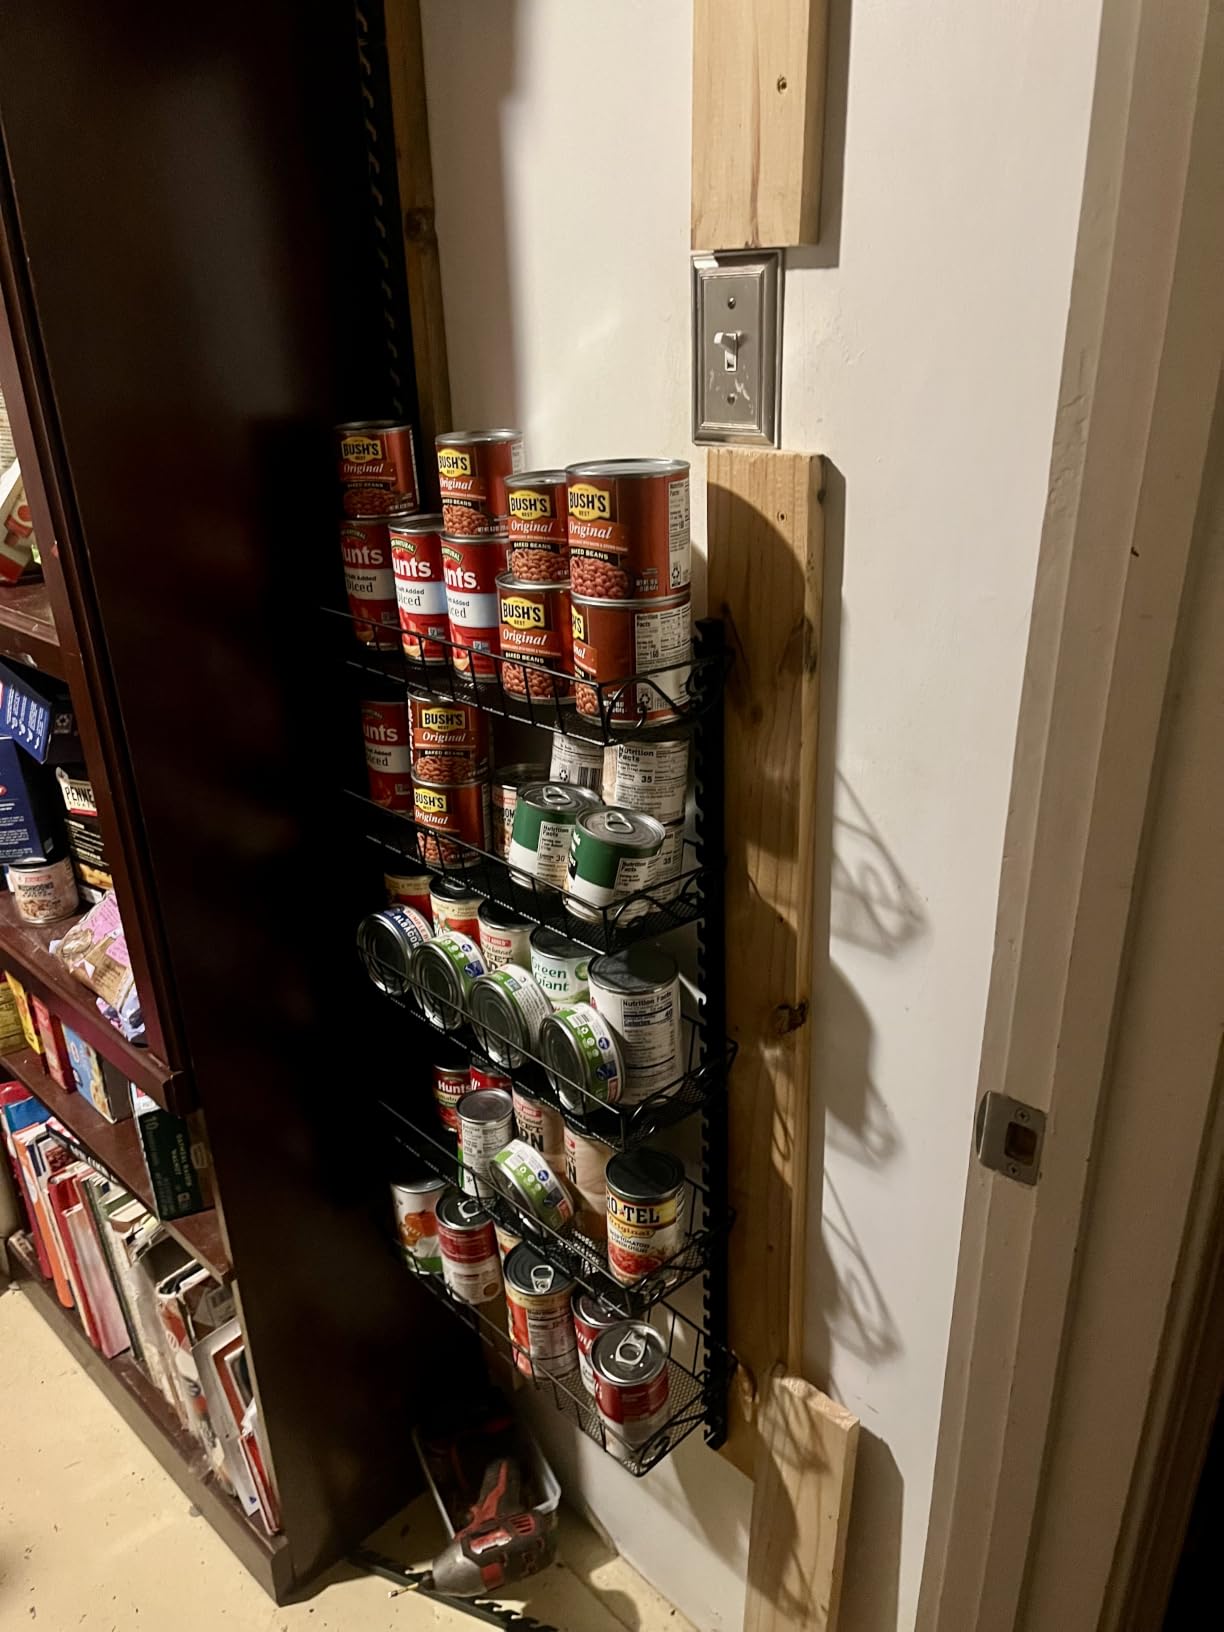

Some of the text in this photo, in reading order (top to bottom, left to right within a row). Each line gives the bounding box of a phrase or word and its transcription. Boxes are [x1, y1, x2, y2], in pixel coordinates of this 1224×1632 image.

[343, 443, 379, 456] BUSH'S
[343, 463, 384, 474] Original
[510, 497, 548, 513] BUSH'S
[569, 491, 606, 513] BUSH'S
[511, 520, 553, 534] Original
[569, 521, 613, 539] Original
[391, 556, 431, 578] unts
[503, 602, 541, 622] BUSH'S
[503, 629, 547, 646] Original
[424, 713, 463, 726] BUSH'S
[422, 732, 466, 743] Original
[618, 746, 654, 758] Nutrition
[641, 775, 653, 783] 35
[65, 787, 93, 802] PENNE
[393, 914, 420, 949] ALBACOR
[623, 999, 655, 1007] Nutrition
